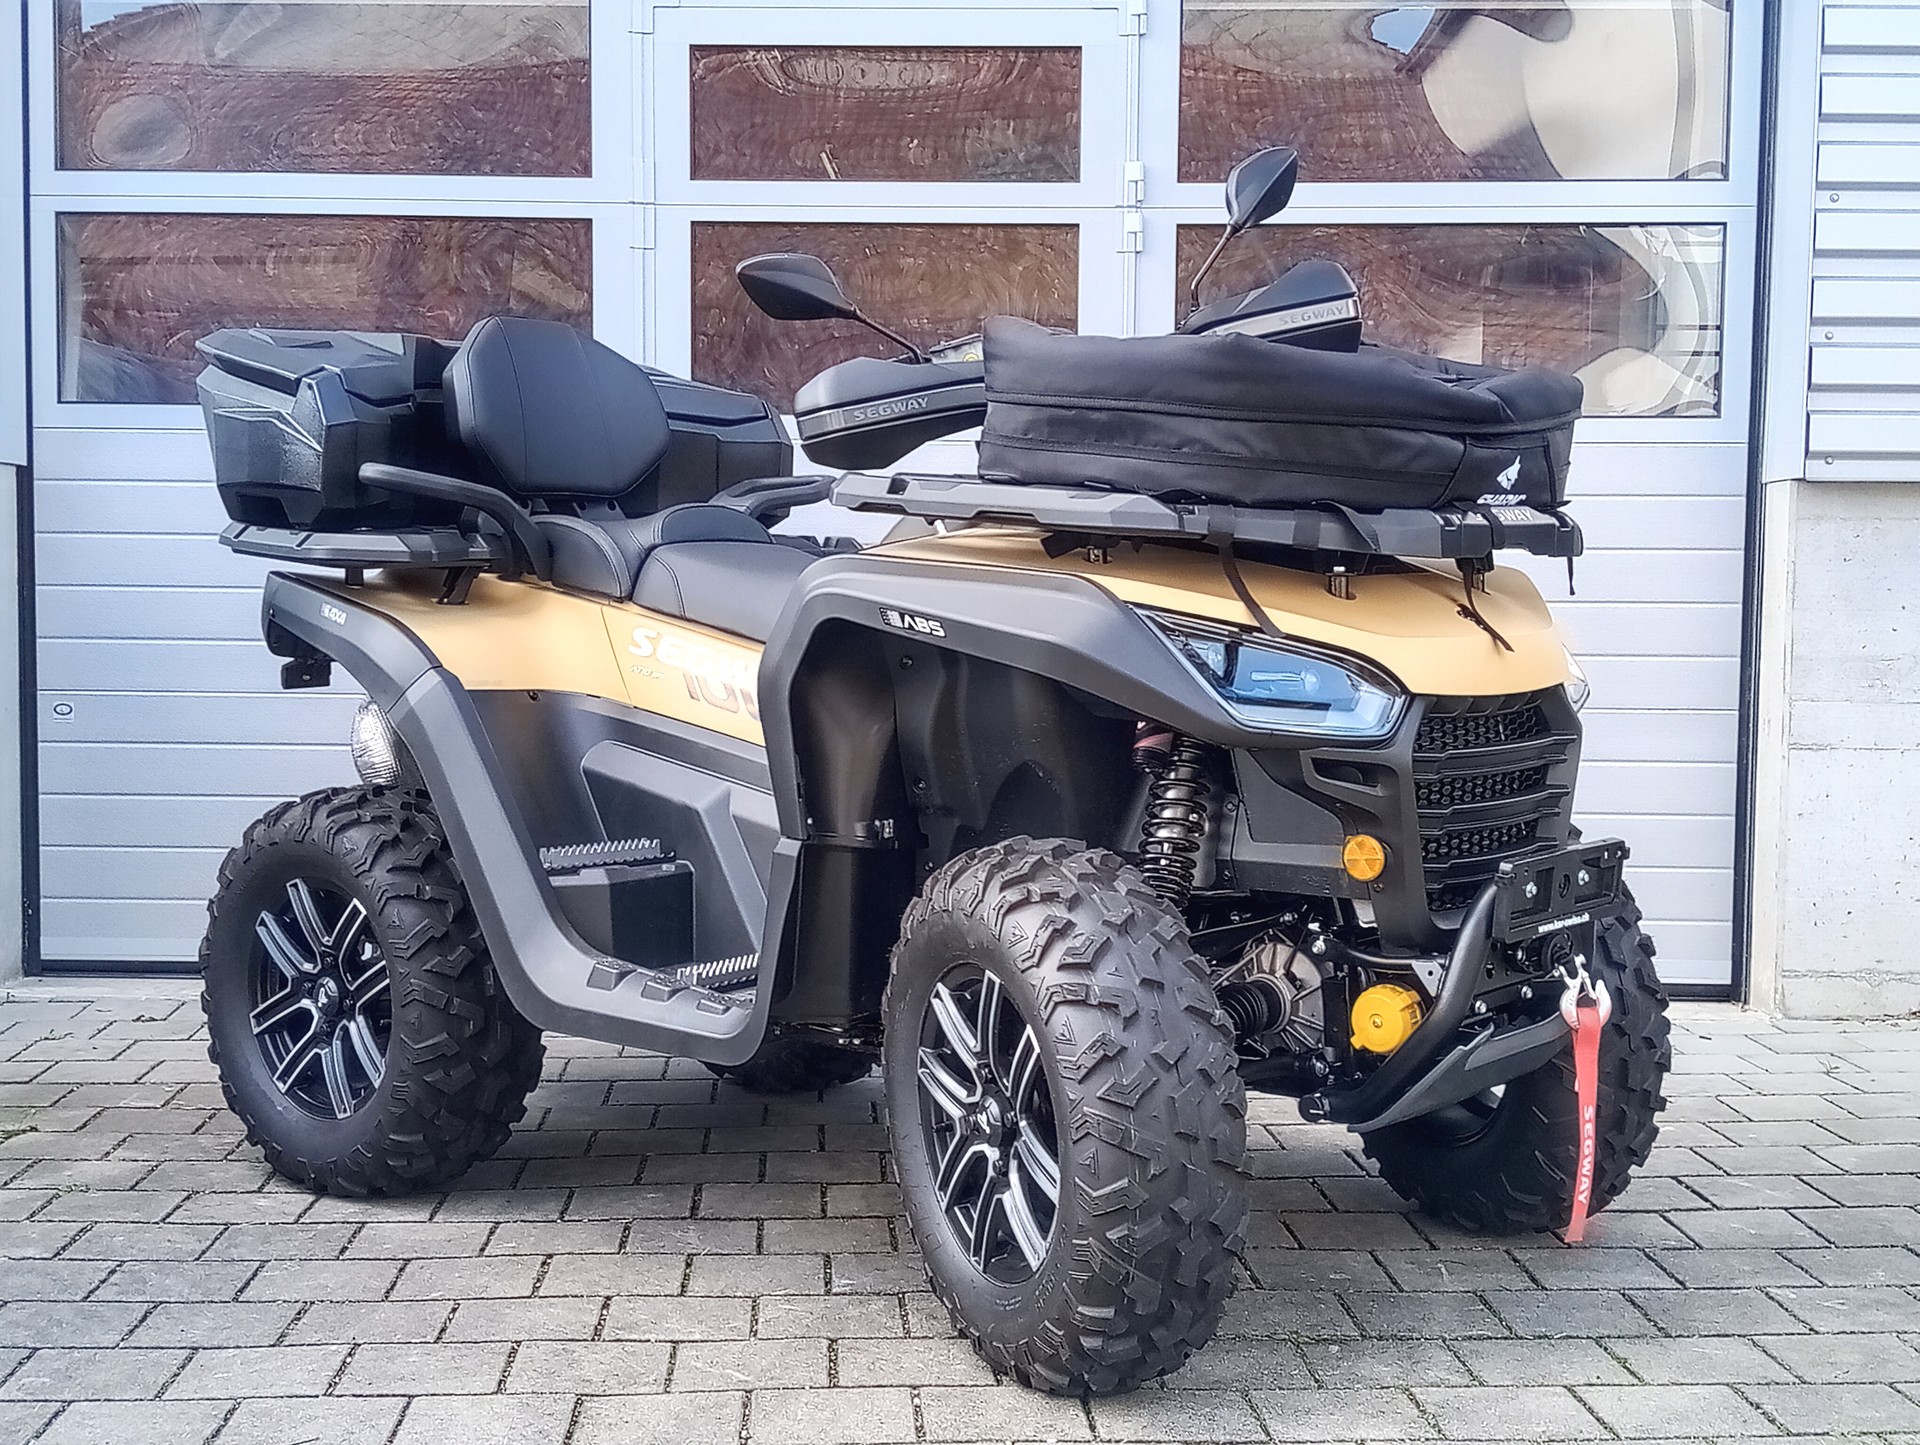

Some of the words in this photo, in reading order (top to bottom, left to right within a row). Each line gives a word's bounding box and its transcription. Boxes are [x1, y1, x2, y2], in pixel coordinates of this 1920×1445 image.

[1278, 306, 1345, 326] SEGWAY
[853, 397, 929, 421] SEGWAY
[904, 614, 946, 637] ABS
[1577, 1104, 1594, 1204] SEGWAY
